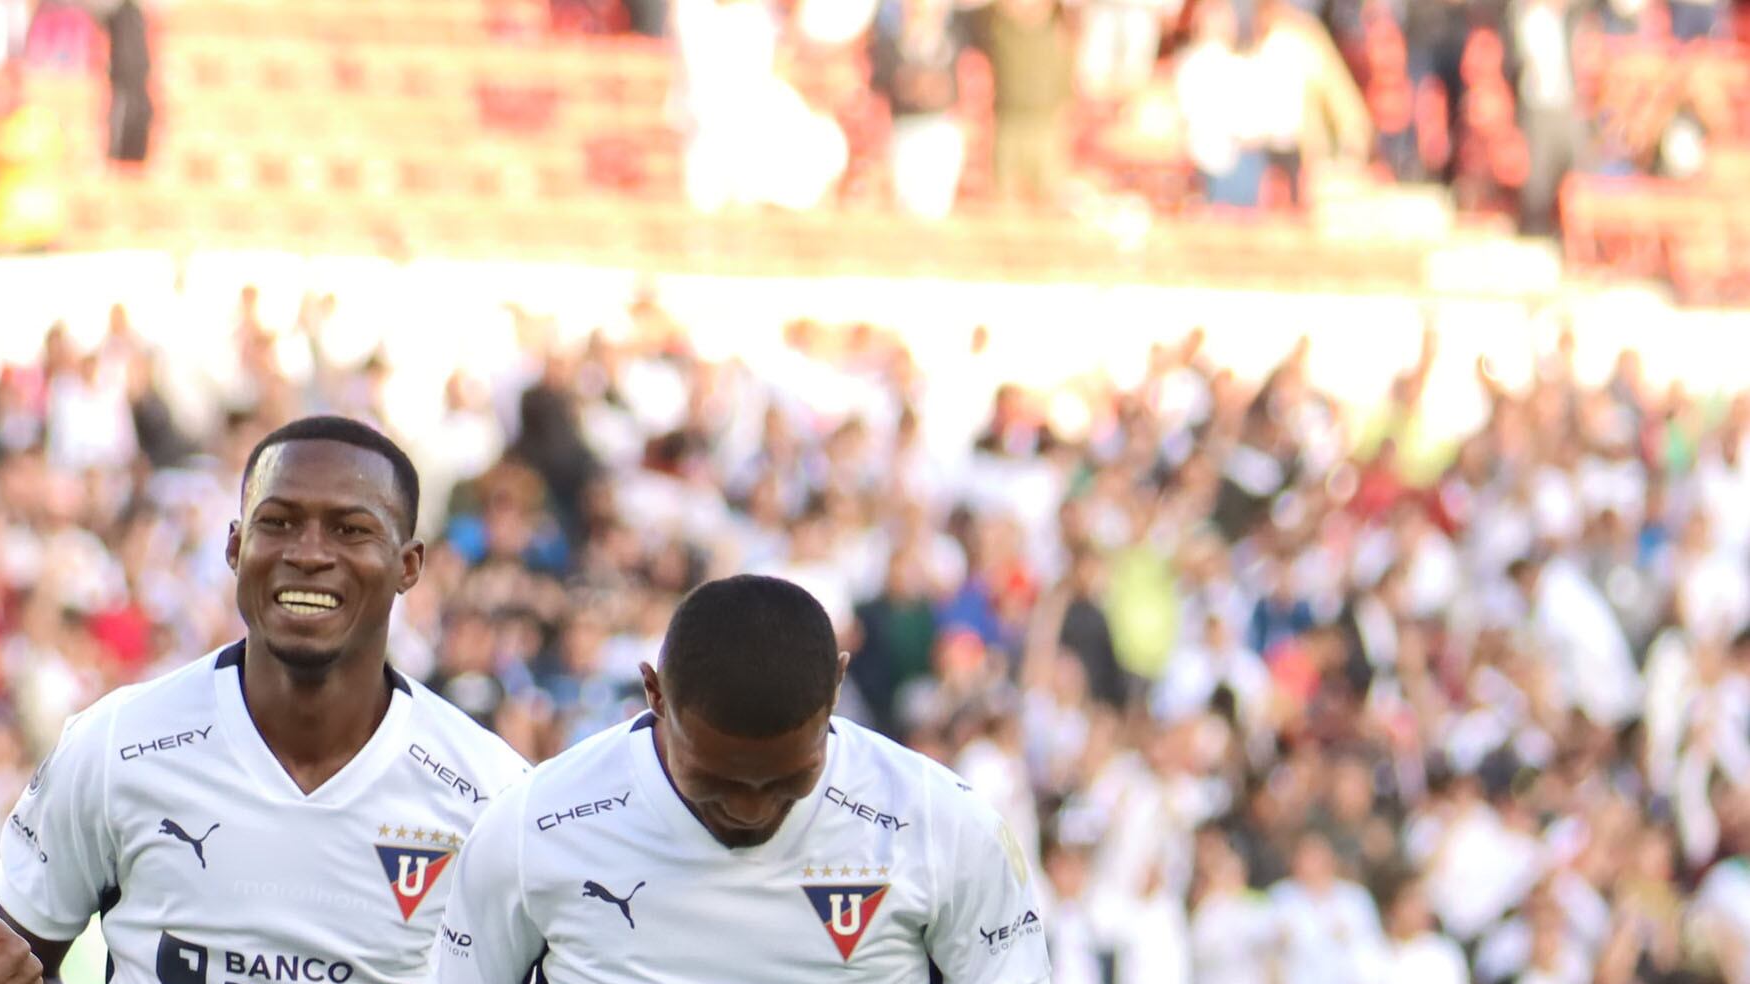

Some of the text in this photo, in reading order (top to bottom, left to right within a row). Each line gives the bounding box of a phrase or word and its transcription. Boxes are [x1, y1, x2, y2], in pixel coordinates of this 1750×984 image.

[120, 725, 212, 760] CHERY
[408, 743, 489, 803] CHERY
[536, 792, 631, 831] CHERY
[824, 786, 909, 831] CHERY
[398, 855, 429, 896] U
[829, 894, 862, 935] U
[225, 951, 354, 984] BANCO
